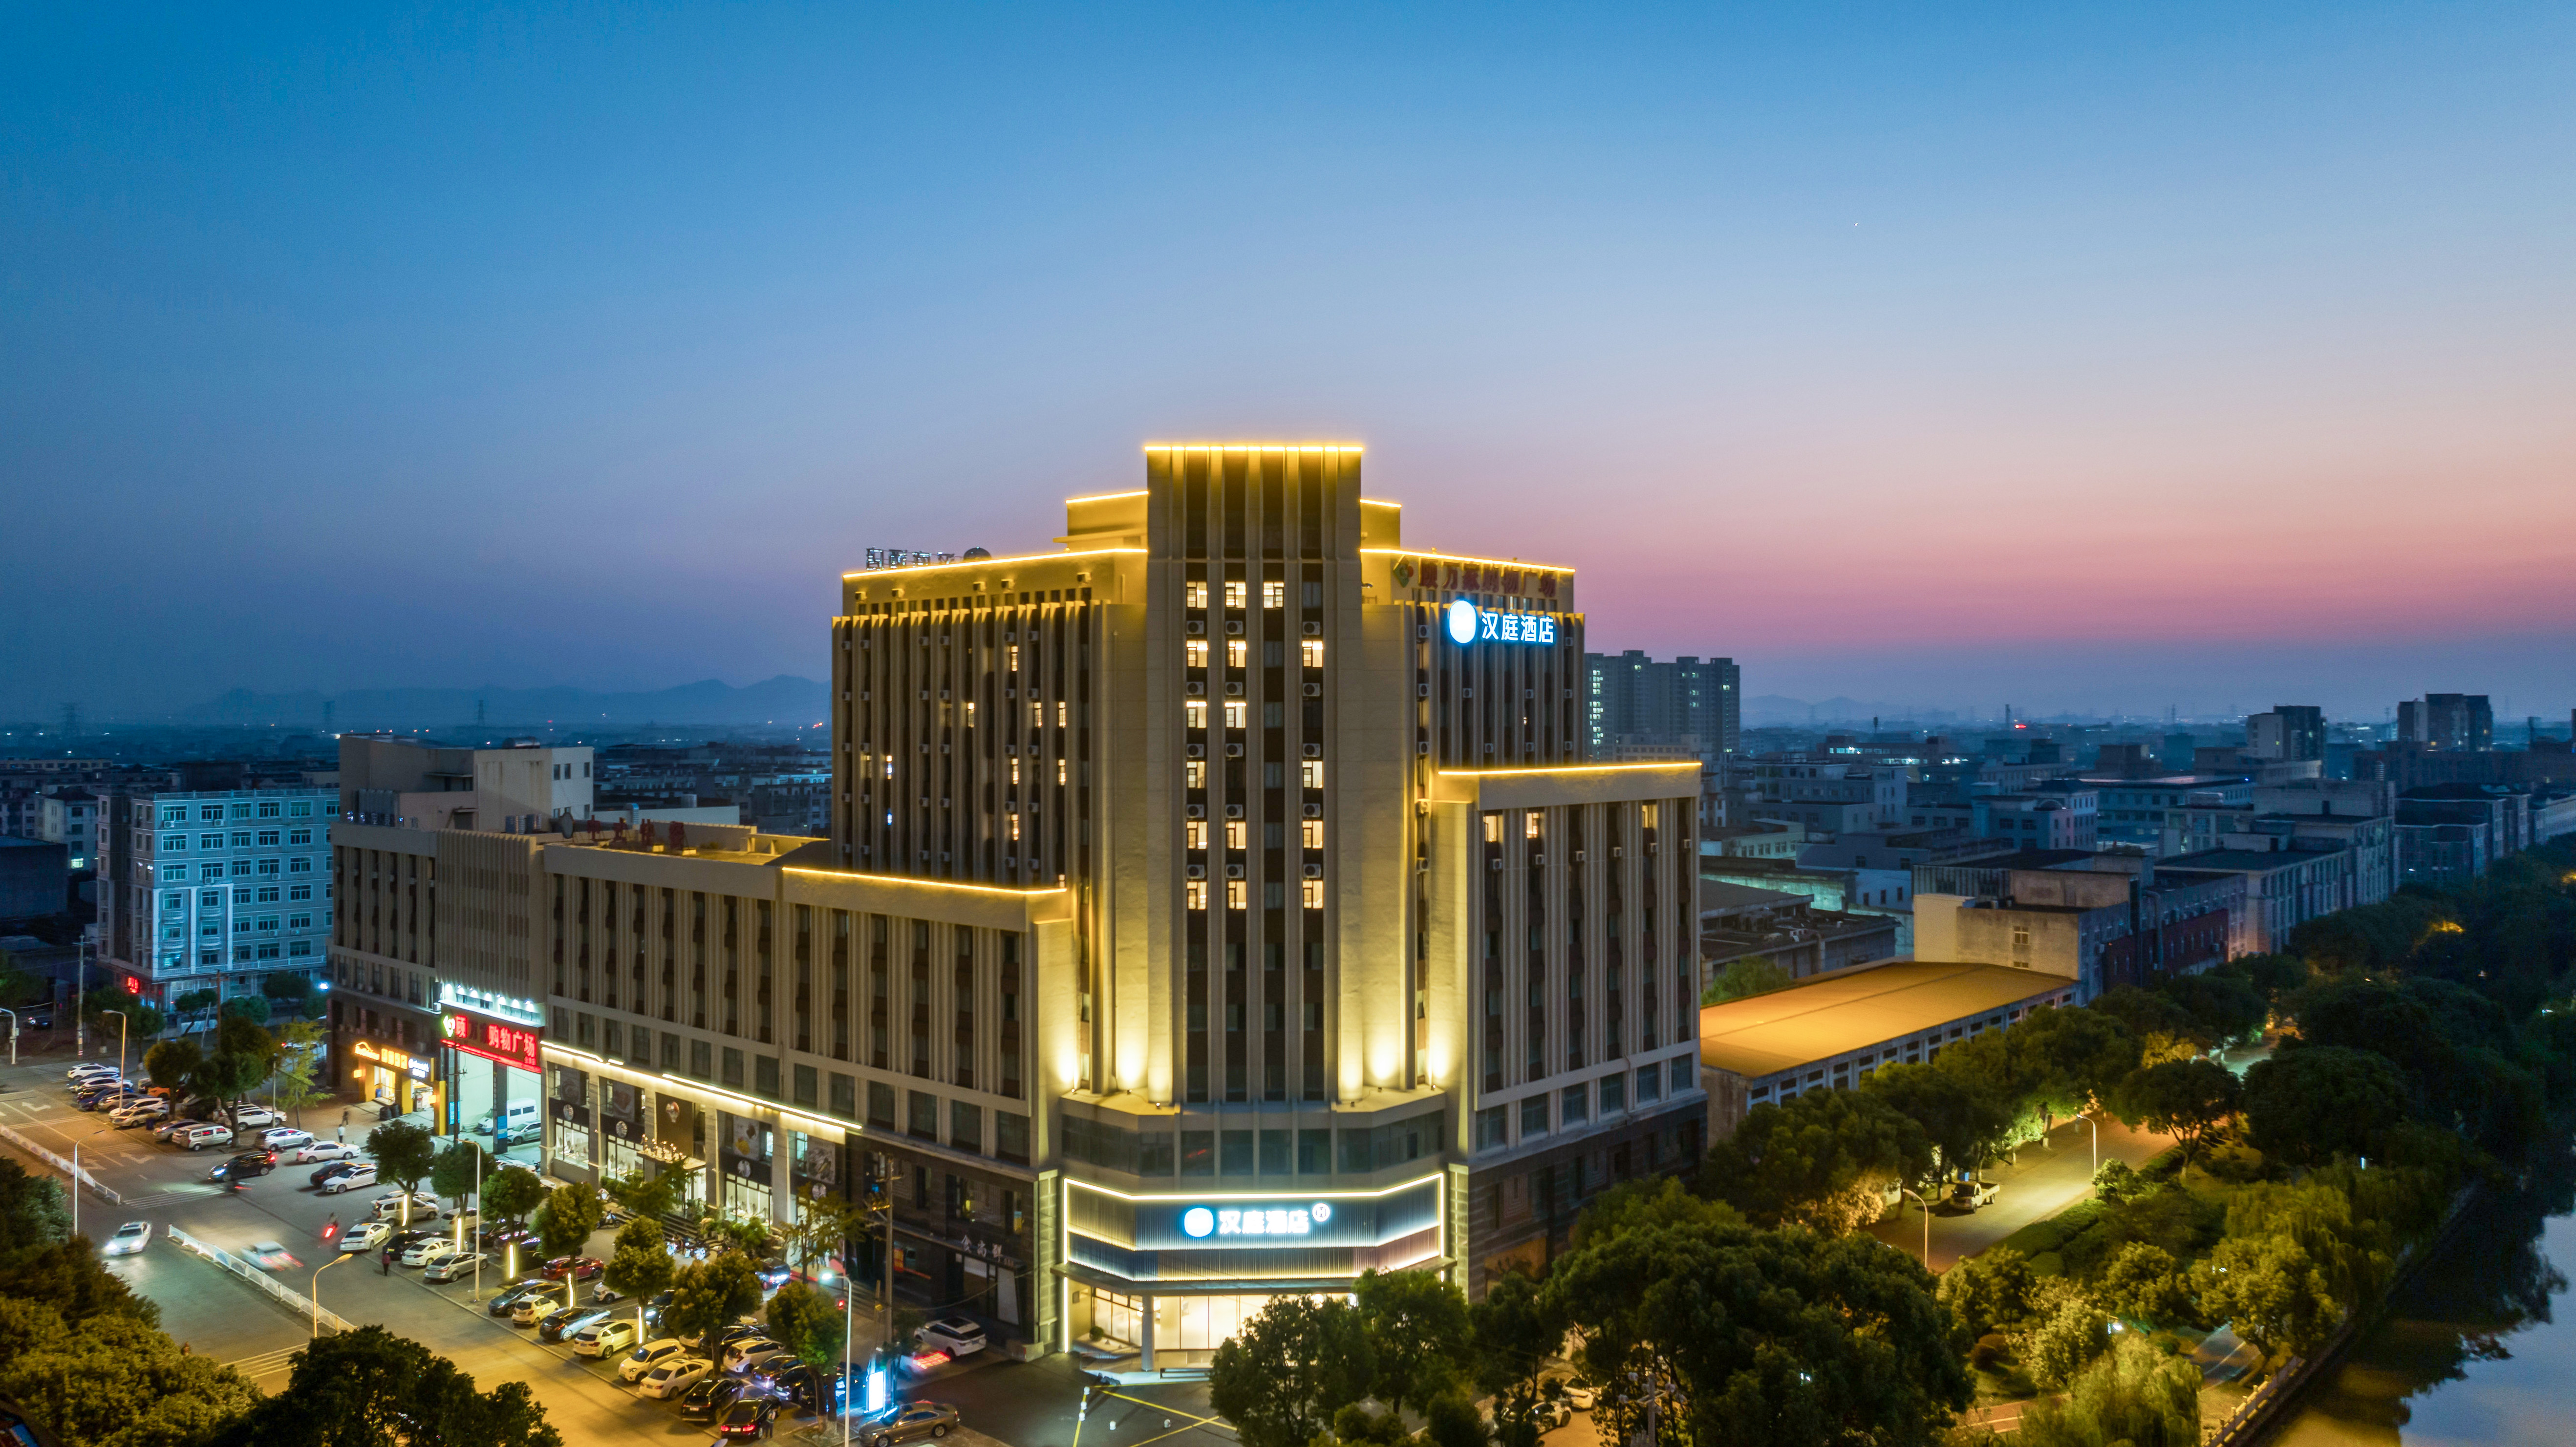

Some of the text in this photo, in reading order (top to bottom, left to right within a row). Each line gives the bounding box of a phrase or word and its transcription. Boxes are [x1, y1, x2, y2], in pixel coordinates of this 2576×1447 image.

[1481, 612, 1554, 643] 汉庭酒店
[1219, 1210, 1309, 1234] 汉庭酒店
